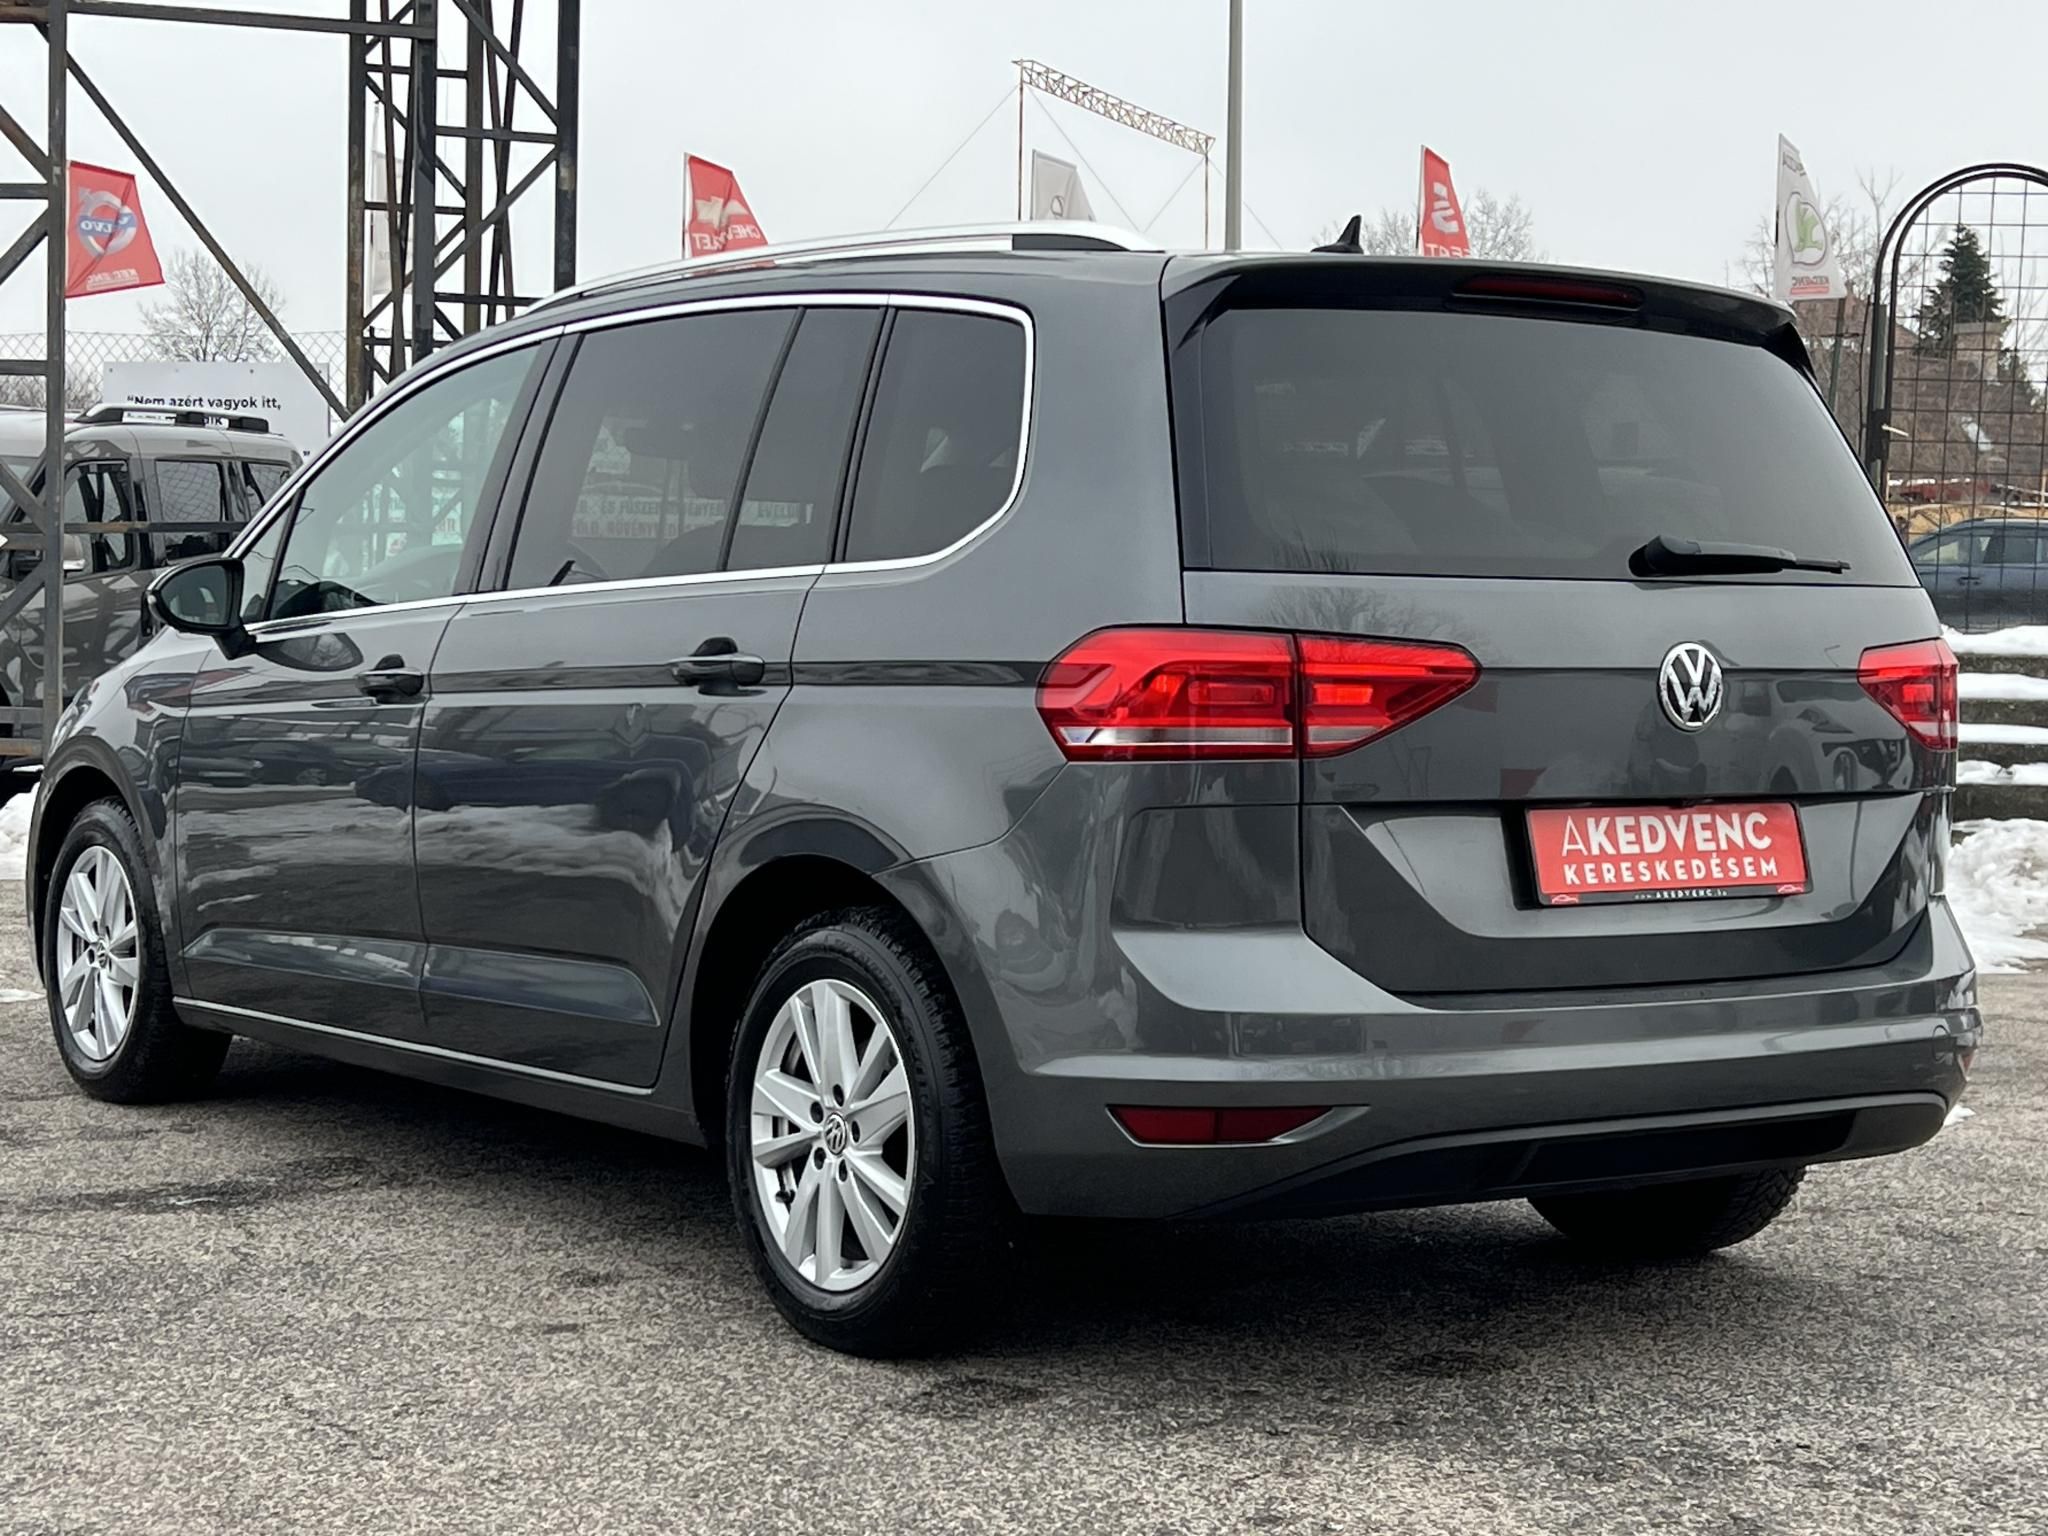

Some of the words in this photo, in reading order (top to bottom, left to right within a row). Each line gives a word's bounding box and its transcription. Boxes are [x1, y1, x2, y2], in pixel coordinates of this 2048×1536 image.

[169, 395, 204, 408] azért
[207, 396, 258, 411] vagyok
[262, 395, 281, 411] itt,
[1563, 852, 1778, 885] KERESKEDÉSEM
